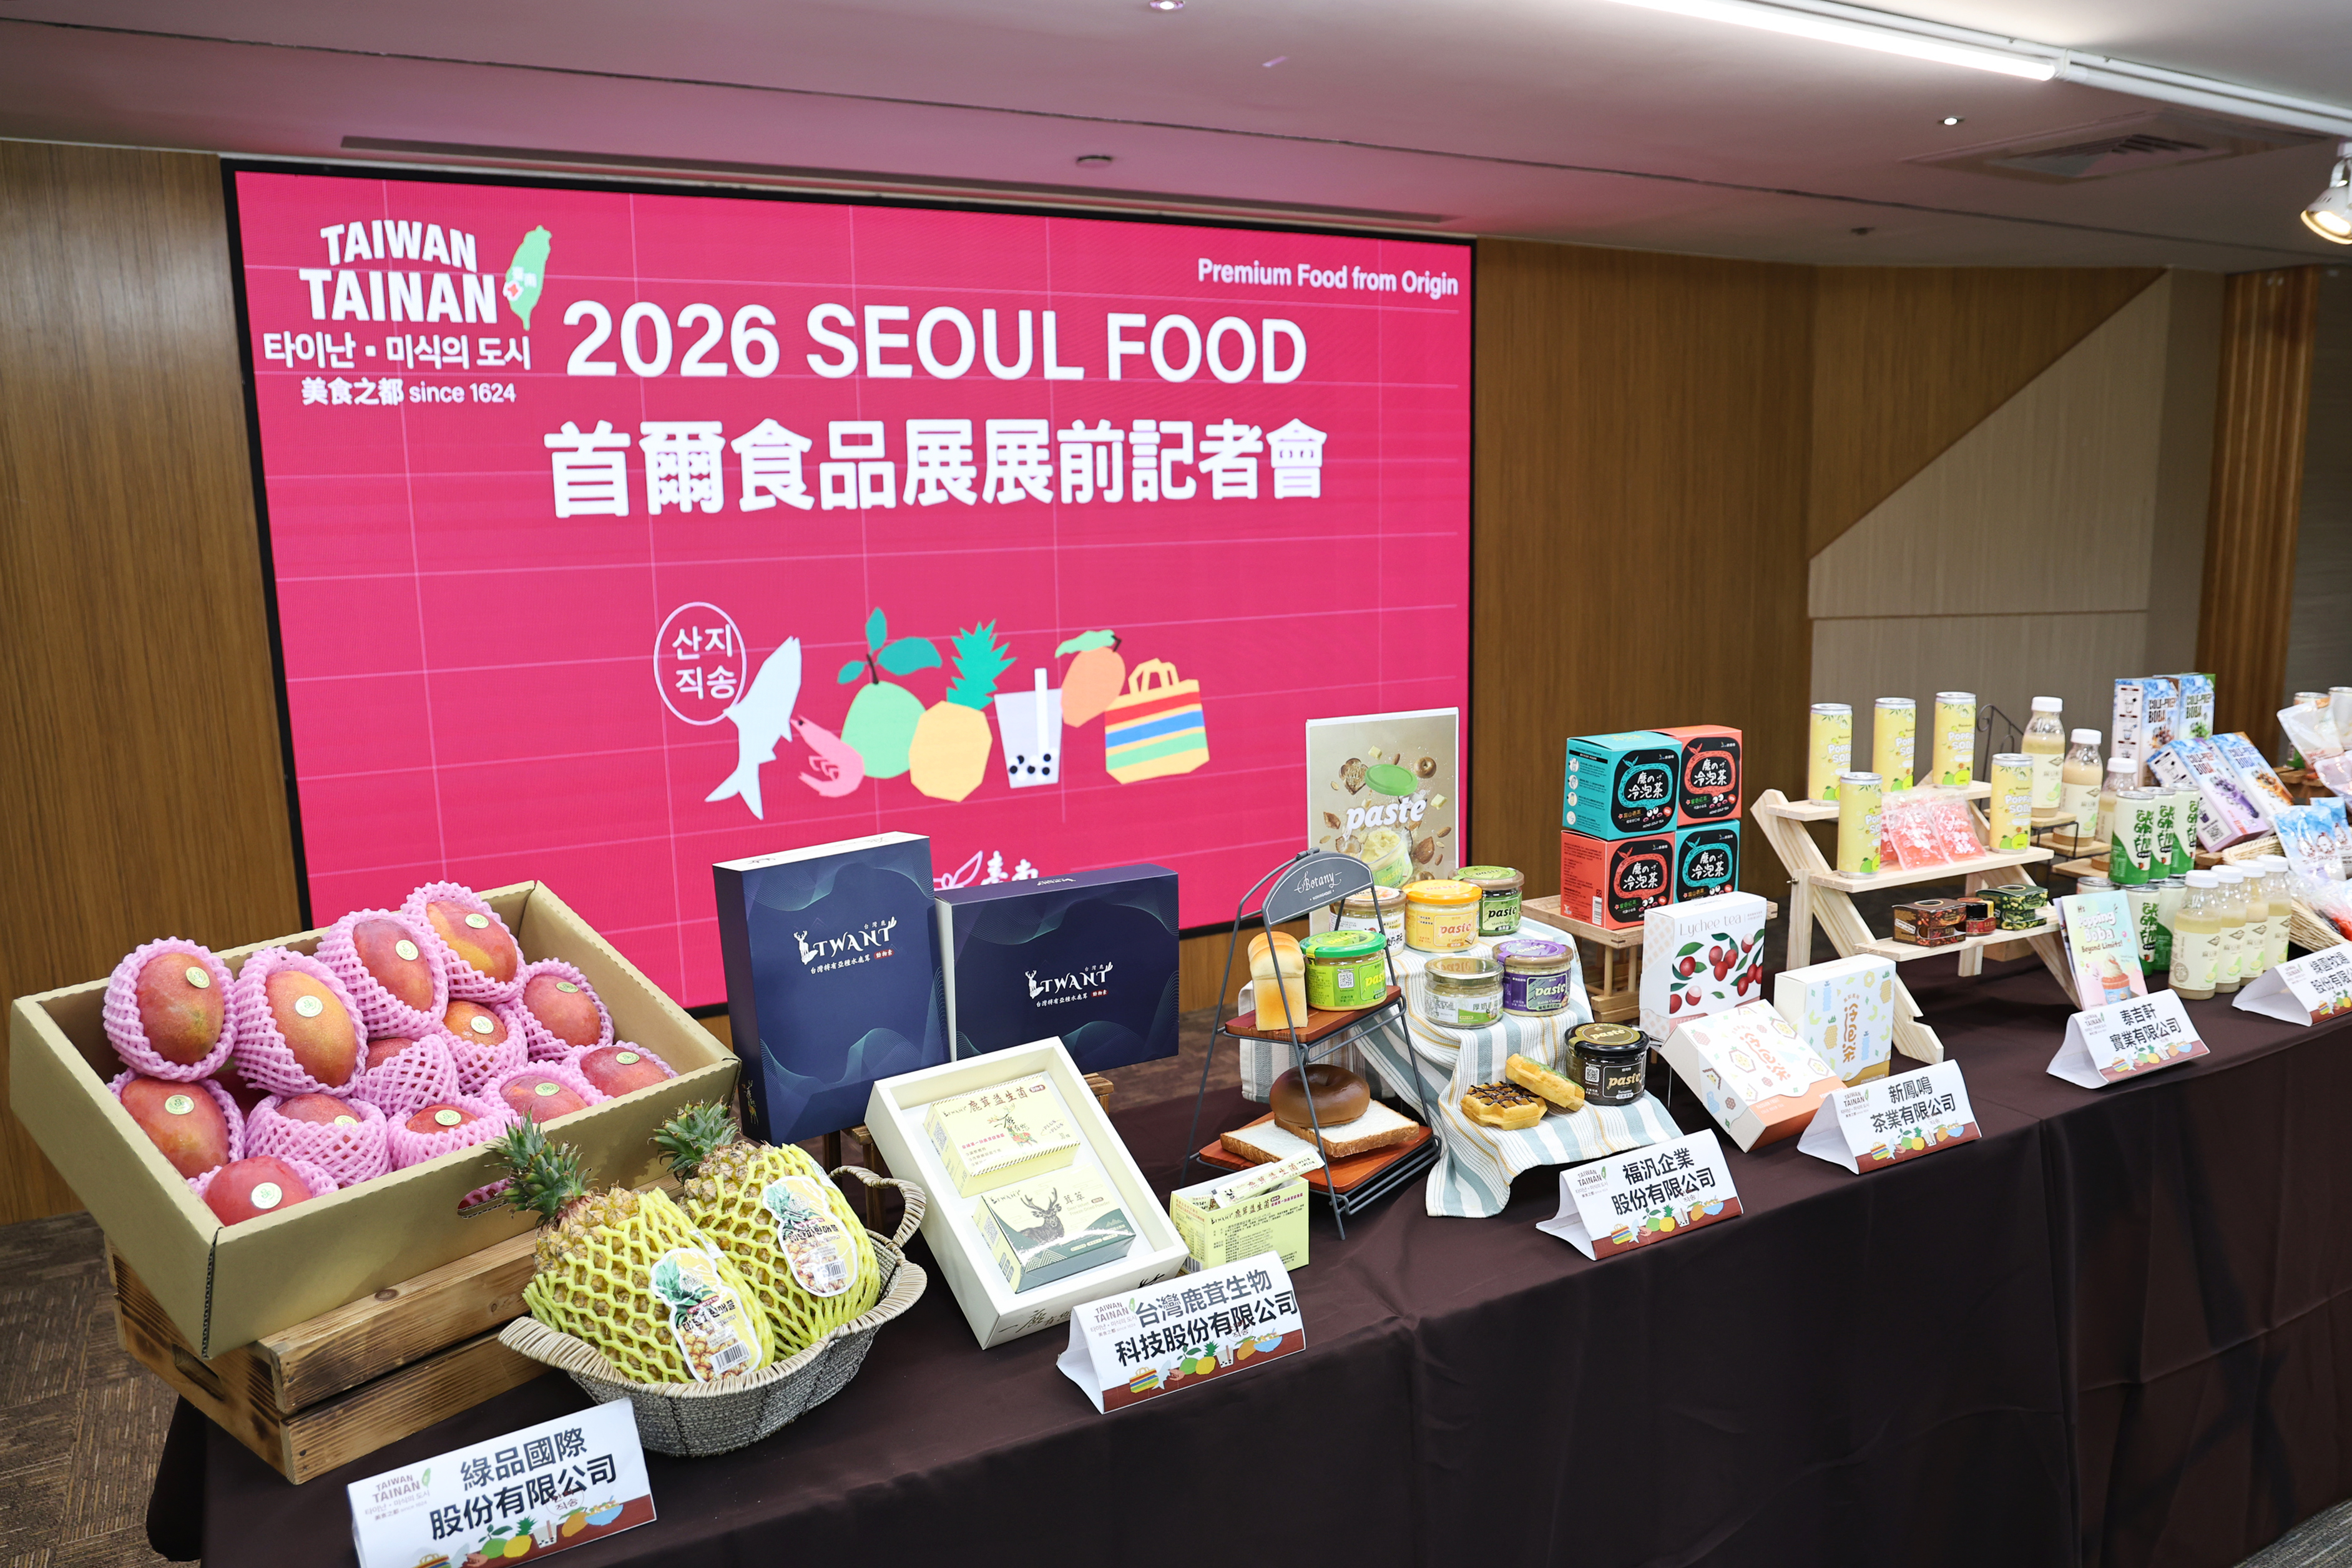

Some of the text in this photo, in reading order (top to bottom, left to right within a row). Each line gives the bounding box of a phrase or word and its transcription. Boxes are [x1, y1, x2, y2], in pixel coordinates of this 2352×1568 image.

[320, 220, 477, 273] TAIWAN
[1198, 258, 1459, 300] Premium Food from Origin
[299, 268, 498, 324] TAINAN
[263, 331, 531, 370] 타이난 미식의 도시
[563, 300, 1307, 383] 2026 SEOUL FOOD
[301, 376, 404, 406] 美食之都
[409, 381, 517, 403] since 1624
[544, 418, 1328, 518] 首爾食品展展前記者會
[672, 624, 733, 660] 산지
[675, 665, 737, 700] 직송
[1693, 768, 1727, 786] 冷泡茶
[1627, 782, 1664, 800] 冷泡茶
[1343, 795, 1428, 841] paste
[1623, 871, 1659, 891] 冷泡茶
[1691, 861, 1725, 880] 冷泡茶
[1294, 871, 1343, 893] Botany
[1438, 922, 1472, 938] paste
[1680, 918, 1720, 938] Lychee
[1724, 914, 1742, 926] tea
[2077, 910, 2117, 928] Popping
[2084, 926, 2115, 943] Boba
[2081, 940, 2124, 954] Beyond Limits!
[2085, 1017, 2102, 1027] TAINAN
[2120, 1003, 2157, 1026] 泰吉軒
[1590, 1029, 1626, 1041] paste
[2109, 1017, 2182, 1052] 實業有限公司
[1606, 1072, 1642, 1090] paste
[1888, 1076, 1933, 1104] 新鳳鳴
[968, 1086, 1028, 1114] 鹿茸益生菌
[1755, 1100, 1771, 1109] PASSION
[1843, 1097, 1866, 1108] TAINAN
[1845, 1091, 1862, 1099] TAIWAN
[1870, 1093, 1956, 1134] 茶業有限公司
[1577, 1169, 1597, 1179] TAIWAN
[1622, 1148, 1695, 1185] 福汎企業
[1577, 1174, 1602, 1187] TAINAN
[1611, 1167, 1717, 1217] 股份有限公司
[1233, 1198, 1270, 1219] 鹿茸益生菌
[1095, 1302, 1123, 1314] TAIWAN
[1135, 1269, 1273, 1328] 台灣鹿茸生物
[1090, 1323, 1107, 1333] 타이난
[1110, 1318, 1126, 1326] 미식의
[1094, 1307, 1129, 1323] TAINAN
[1114, 1290, 1298, 1367] 科技股份有限公司
[1232, 1328, 1250, 1339] 직송
[459, 1426, 587, 1492] 綠品國際
[372, 1480, 421, 1504] TAINAN
[375, 1474, 414, 1492] TAIWAN
[365, 1489, 431, 1515] 타이난 미식의 도시
[429, 1453, 617, 1541] 股份有限公司
[555, 1497, 579, 1511] 직송
